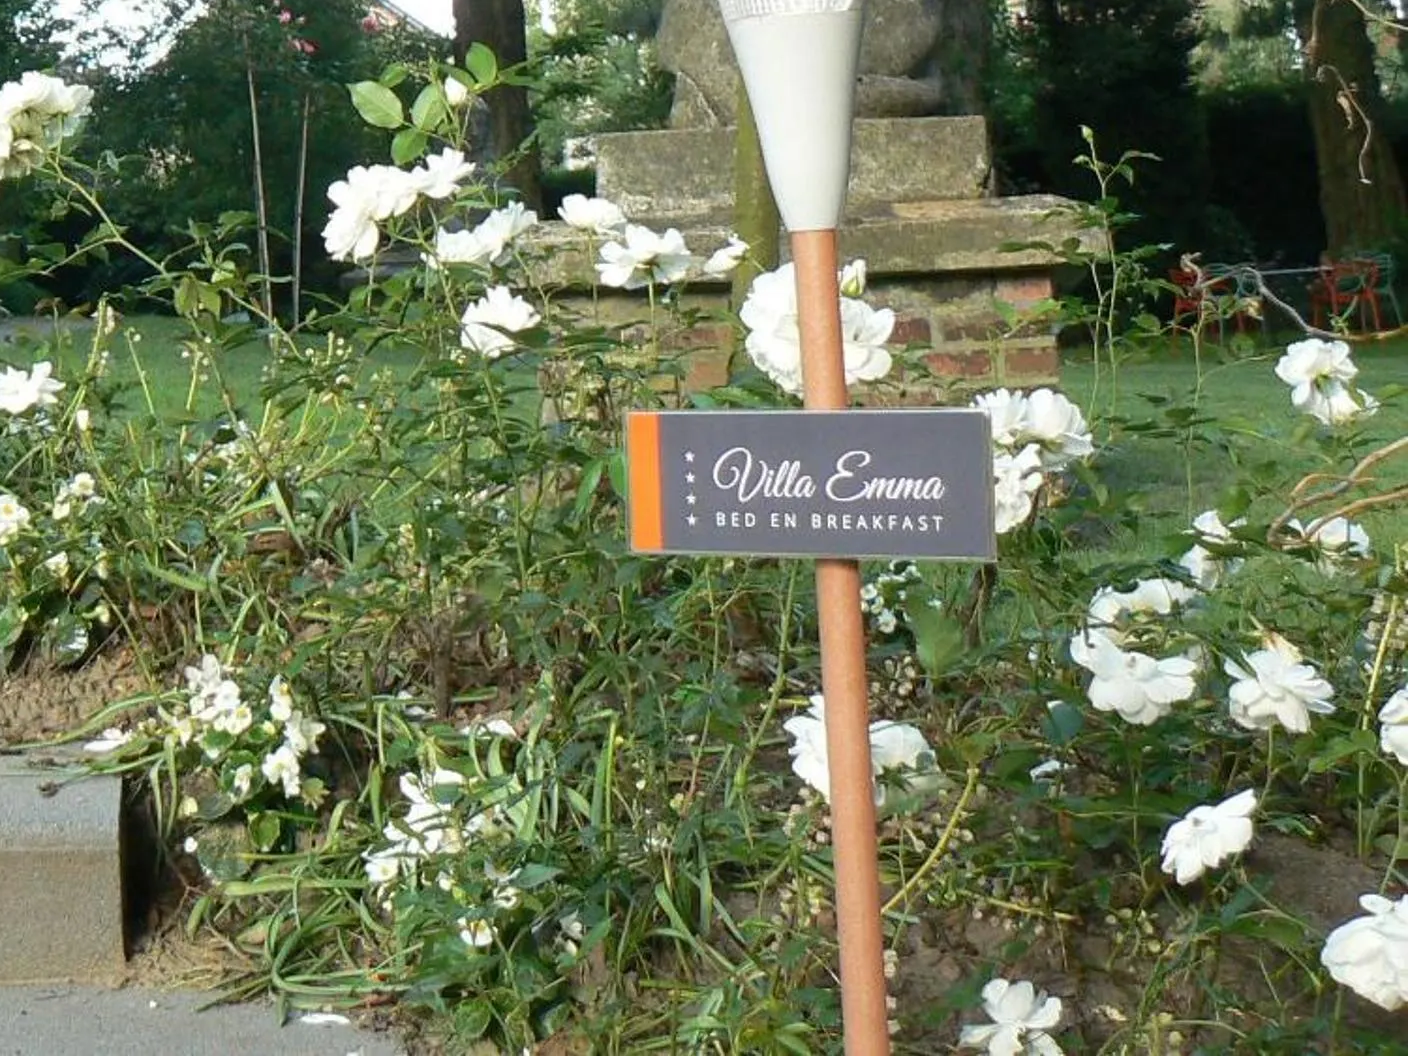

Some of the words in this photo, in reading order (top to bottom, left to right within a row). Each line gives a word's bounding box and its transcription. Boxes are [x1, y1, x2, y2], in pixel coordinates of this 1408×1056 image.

[712, 446, 816, 503] Villa
[824, 450, 945, 502] Emma
[715, 511, 756, 528] BED
[770, 512, 797, 529] EN
[811, 513, 944, 532] BREAKFAST
